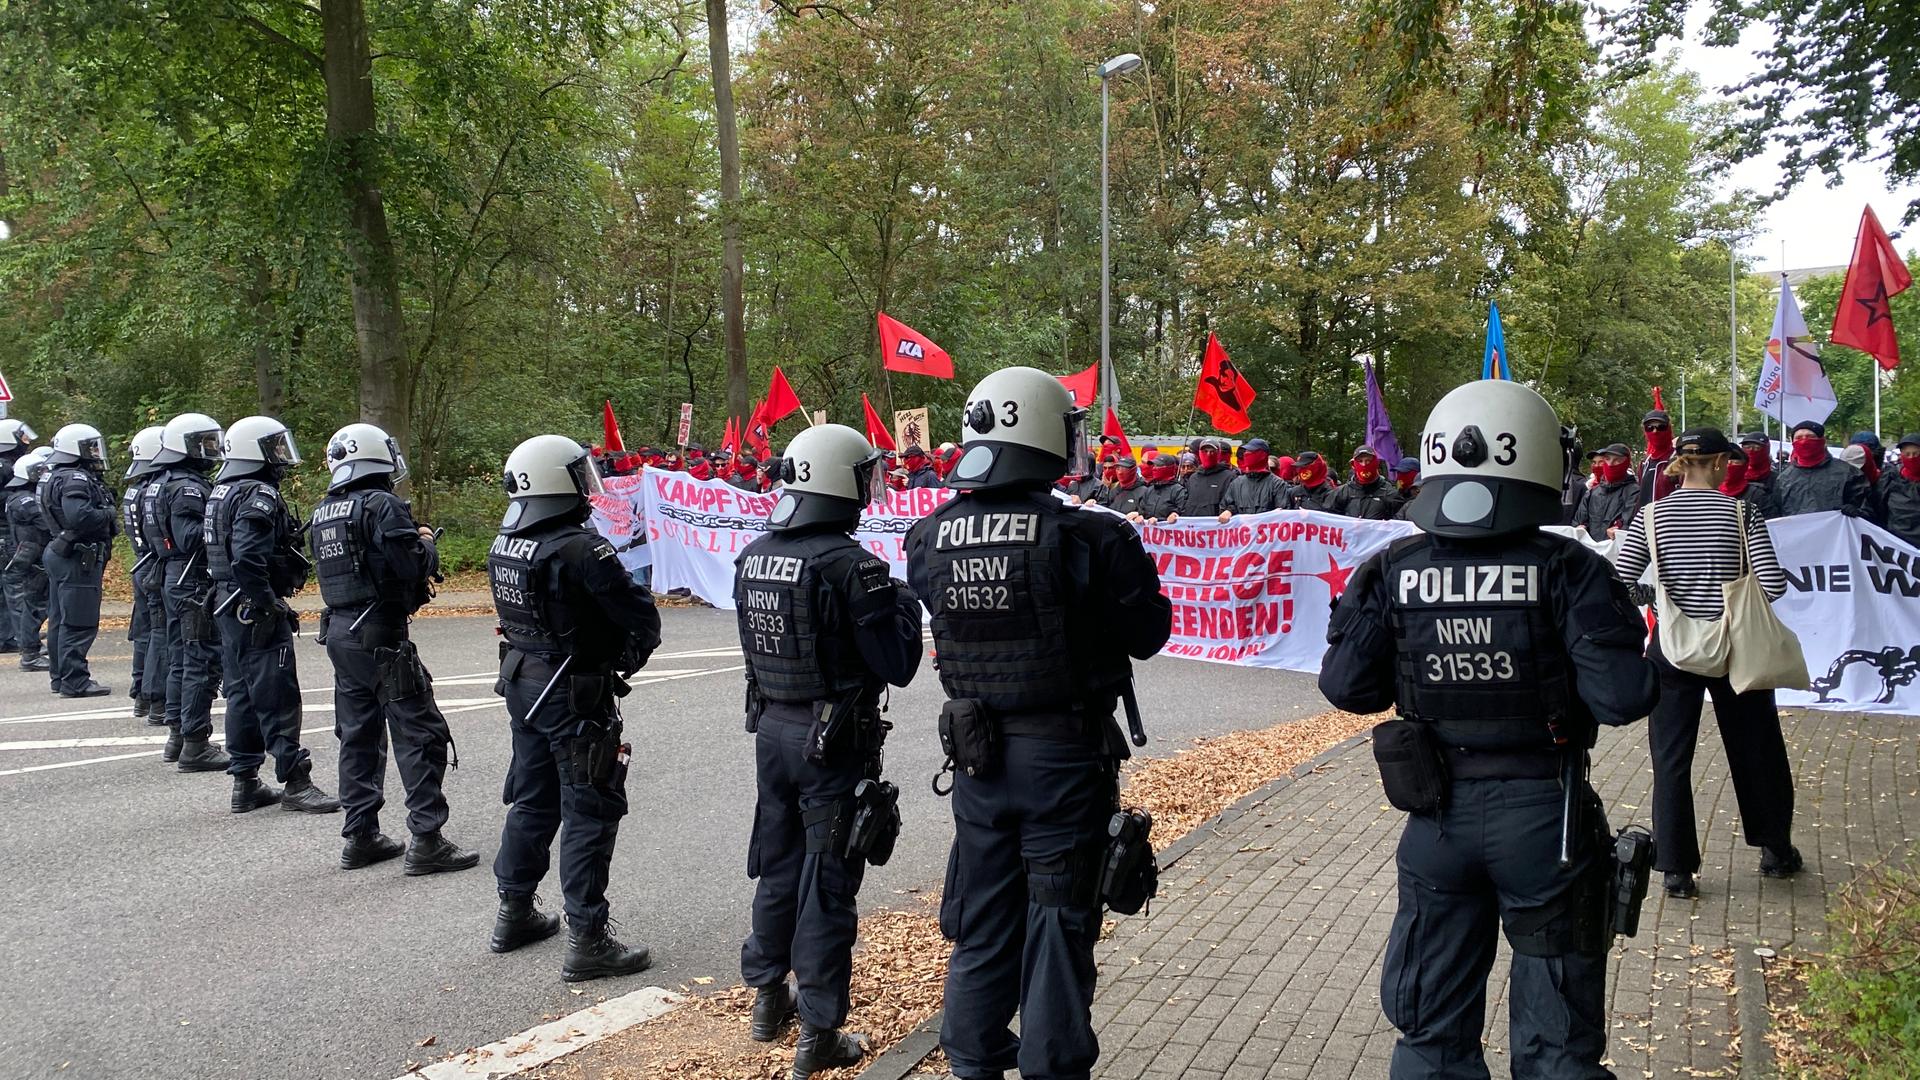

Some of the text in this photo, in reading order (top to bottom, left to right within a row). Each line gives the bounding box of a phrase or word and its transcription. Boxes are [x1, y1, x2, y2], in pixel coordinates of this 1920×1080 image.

[898, 341, 924, 358] KA
[1000, 400, 1019, 428] 3
[134, 445, 141, 456] 2
[225, 439, 232, 453] 3
[348, 439, 358, 454] 3
[1424, 432, 1518, 465] 15 3
[518, 472, 531, 490] 3
[798, 460, 811, 482] 3
[655, 475, 732, 513] KAMPF
[313, 500, 355, 525] POLIZEI
[320, 527, 337, 542] NRW
[936, 513, 1039, 549] POLIZEI
[1142, 521, 1348, 553] AUFRÜSTUNG STOPPEN,
[319, 542, 344, 560] 31533
[489, 534, 539, 561] POLIZEI
[494, 565, 519, 585] NRW
[741, 555, 804, 583] POLIZEI
[952, 556, 1009, 583] NRW
[494, 584, 524, 605] 31533
[945, 585, 1010, 610] 31532
[1399, 565, 1539, 605] POLIZEI
[747, 589, 780, 611] NRW
[747, 611, 785, 634] 31533
[1170, 598, 1294, 641] EENDEN!
[1436, 616, 1492, 645] NRW
[755, 633, 781, 655] FLT
[1425, 650, 1514, 682] 31533
